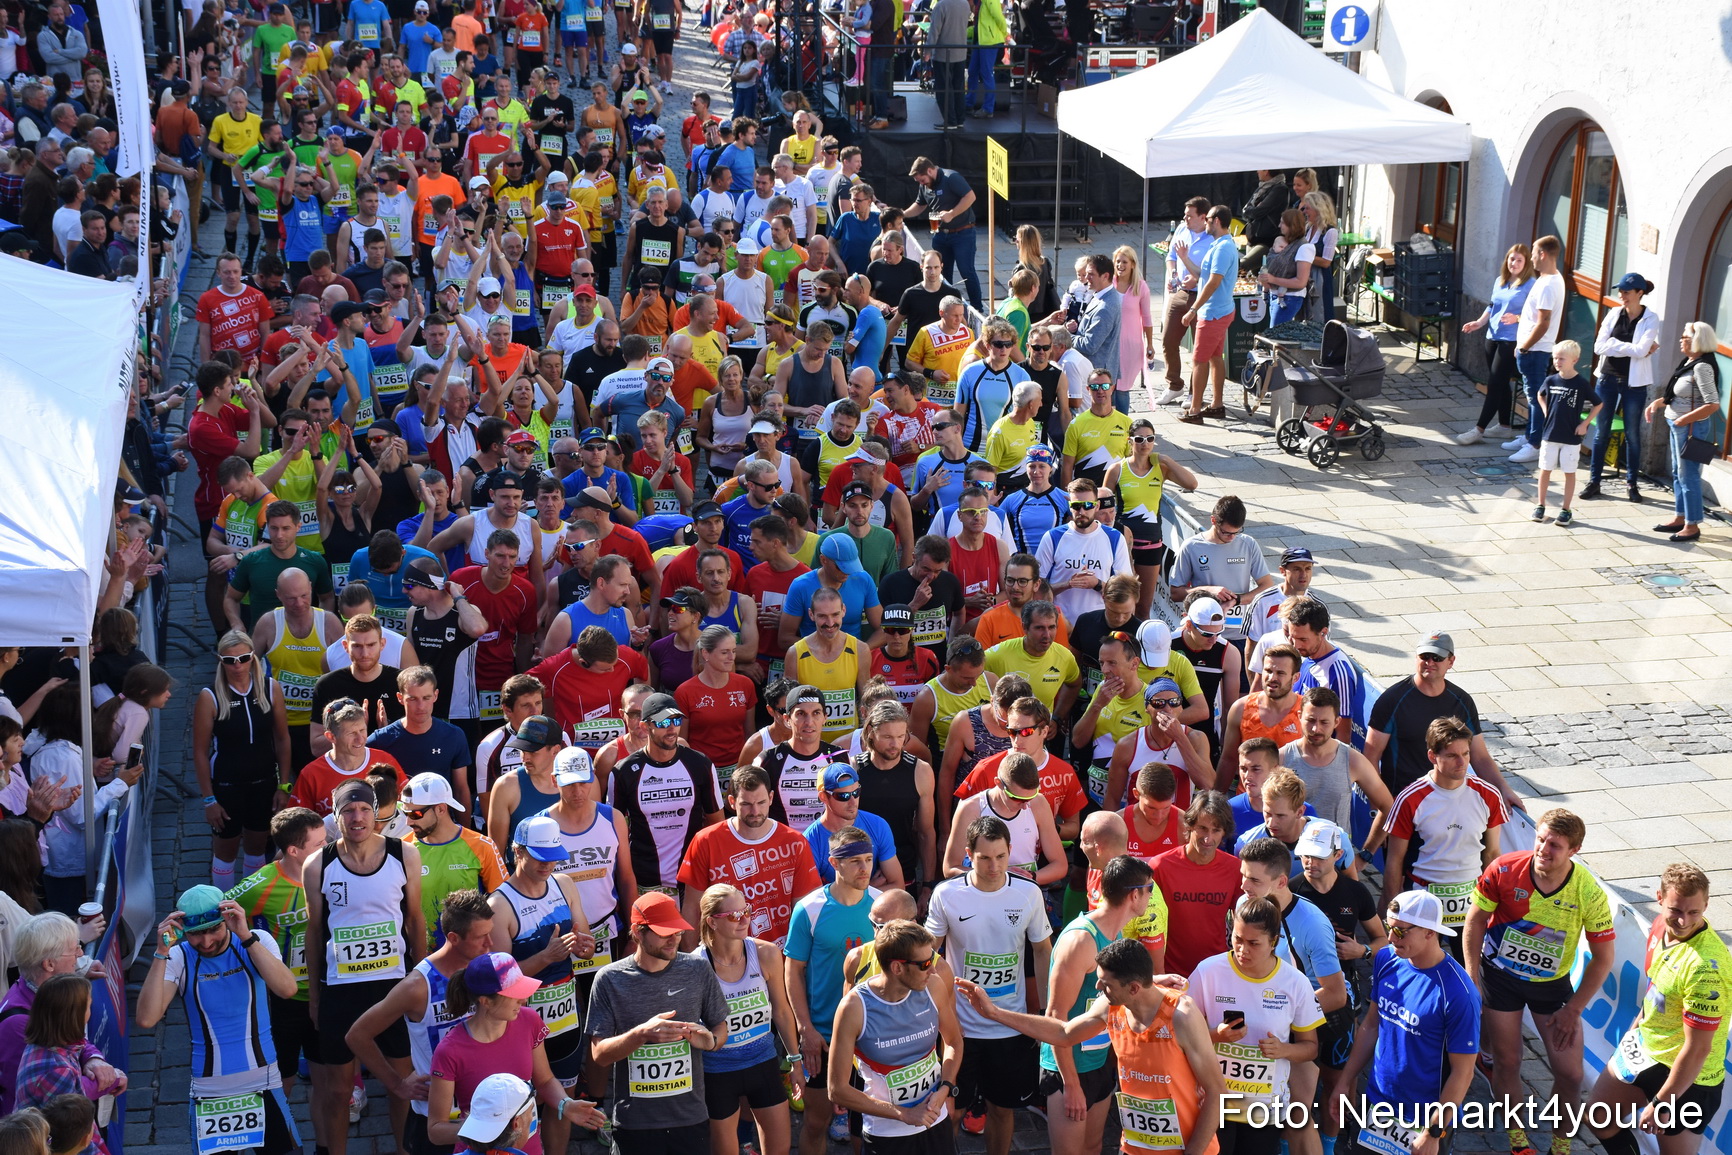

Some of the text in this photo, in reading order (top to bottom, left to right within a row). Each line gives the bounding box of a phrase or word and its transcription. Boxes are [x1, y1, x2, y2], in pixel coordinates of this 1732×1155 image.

[992, 150, 1003, 169] FUN
[992, 166, 1003, 187] RUN
[644, 241, 670, 249] BOCK
[645, 249, 667, 258] 1126
[935, 347, 954, 356] MAX
[375, 366, 408, 374] BOCK
[378, 373, 404, 384] 1265
[930, 388, 955, 398] 2376
[884, 610, 911, 620] OAKLEY
[575, 720, 622, 730] BOCK
[581, 731, 619, 741] 2573
[1128, 842, 1139, 850] LG
[340, 923, 391, 939] BOCK
[342, 940, 391, 961] 1233
[1512, 931, 1558, 956] BOCK
[572, 960, 594, 970] FRED
[970, 954, 1016, 966] BOCK
[1505, 945, 1554, 971] 2698
[348, 960, 389, 972] MARKUS
[1512, 961, 1543, 977] MAX
[970, 968, 1013, 985] 2735
[534, 983, 573, 1002] BOCK
[738, 987, 760, 997] FINANZ
[1263, 990, 1274, 998] 20
[1378, 996, 1420, 1027] SYSCAD
[727, 1010, 765, 1034] 502
[734, 1032, 751, 1042] EVA
[633, 1043, 685, 1059] BOCK
[636, 1062, 685, 1080] 1072
[893, 1054, 934, 1085] BOCK
[1220, 1060, 1267, 1080] 1367
[1130, 1071, 1172, 1084] FitterTEC
[635, 1080, 687, 1091] CHRISTIAN
[897, 1070, 936, 1102] 2741
[203, 1096, 254, 1114] BOCK
[1122, 1097, 1168, 1113] BOCK
[205, 1111, 258, 1135] 2628
[1127, 1113, 1173, 1133] 1362
[216, 1135, 249, 1146] ARMIN
[1138, 1133, 1177, 1145] STEFAN
